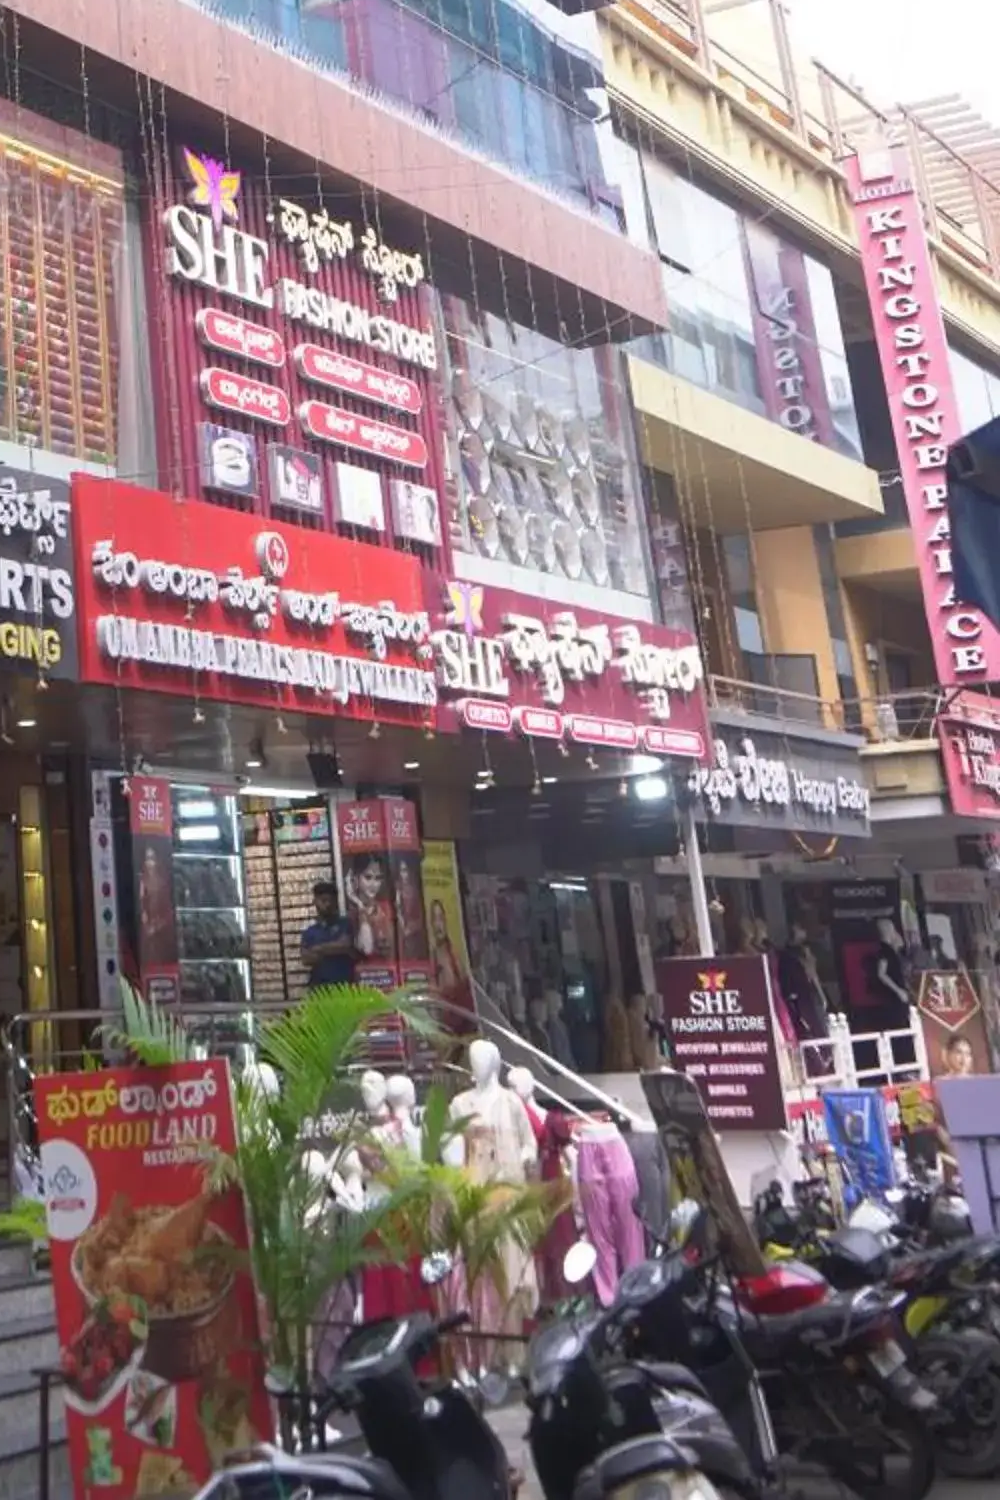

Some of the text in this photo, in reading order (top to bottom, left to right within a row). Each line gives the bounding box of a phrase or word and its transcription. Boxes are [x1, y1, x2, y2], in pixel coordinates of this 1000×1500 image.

[166, 203, 273, 308] SHE
[371, 315, 437, 370] STORE
[432, 630, 509, 697] SHE
[138, 802, 165, 822] SHE
[837, 776, 871, 819] Baby
[343, 822, 378, 841] SHE
[689, 990, 743, 1015] SHE
[671, 1015, 766, 1033] FASHION STORE
